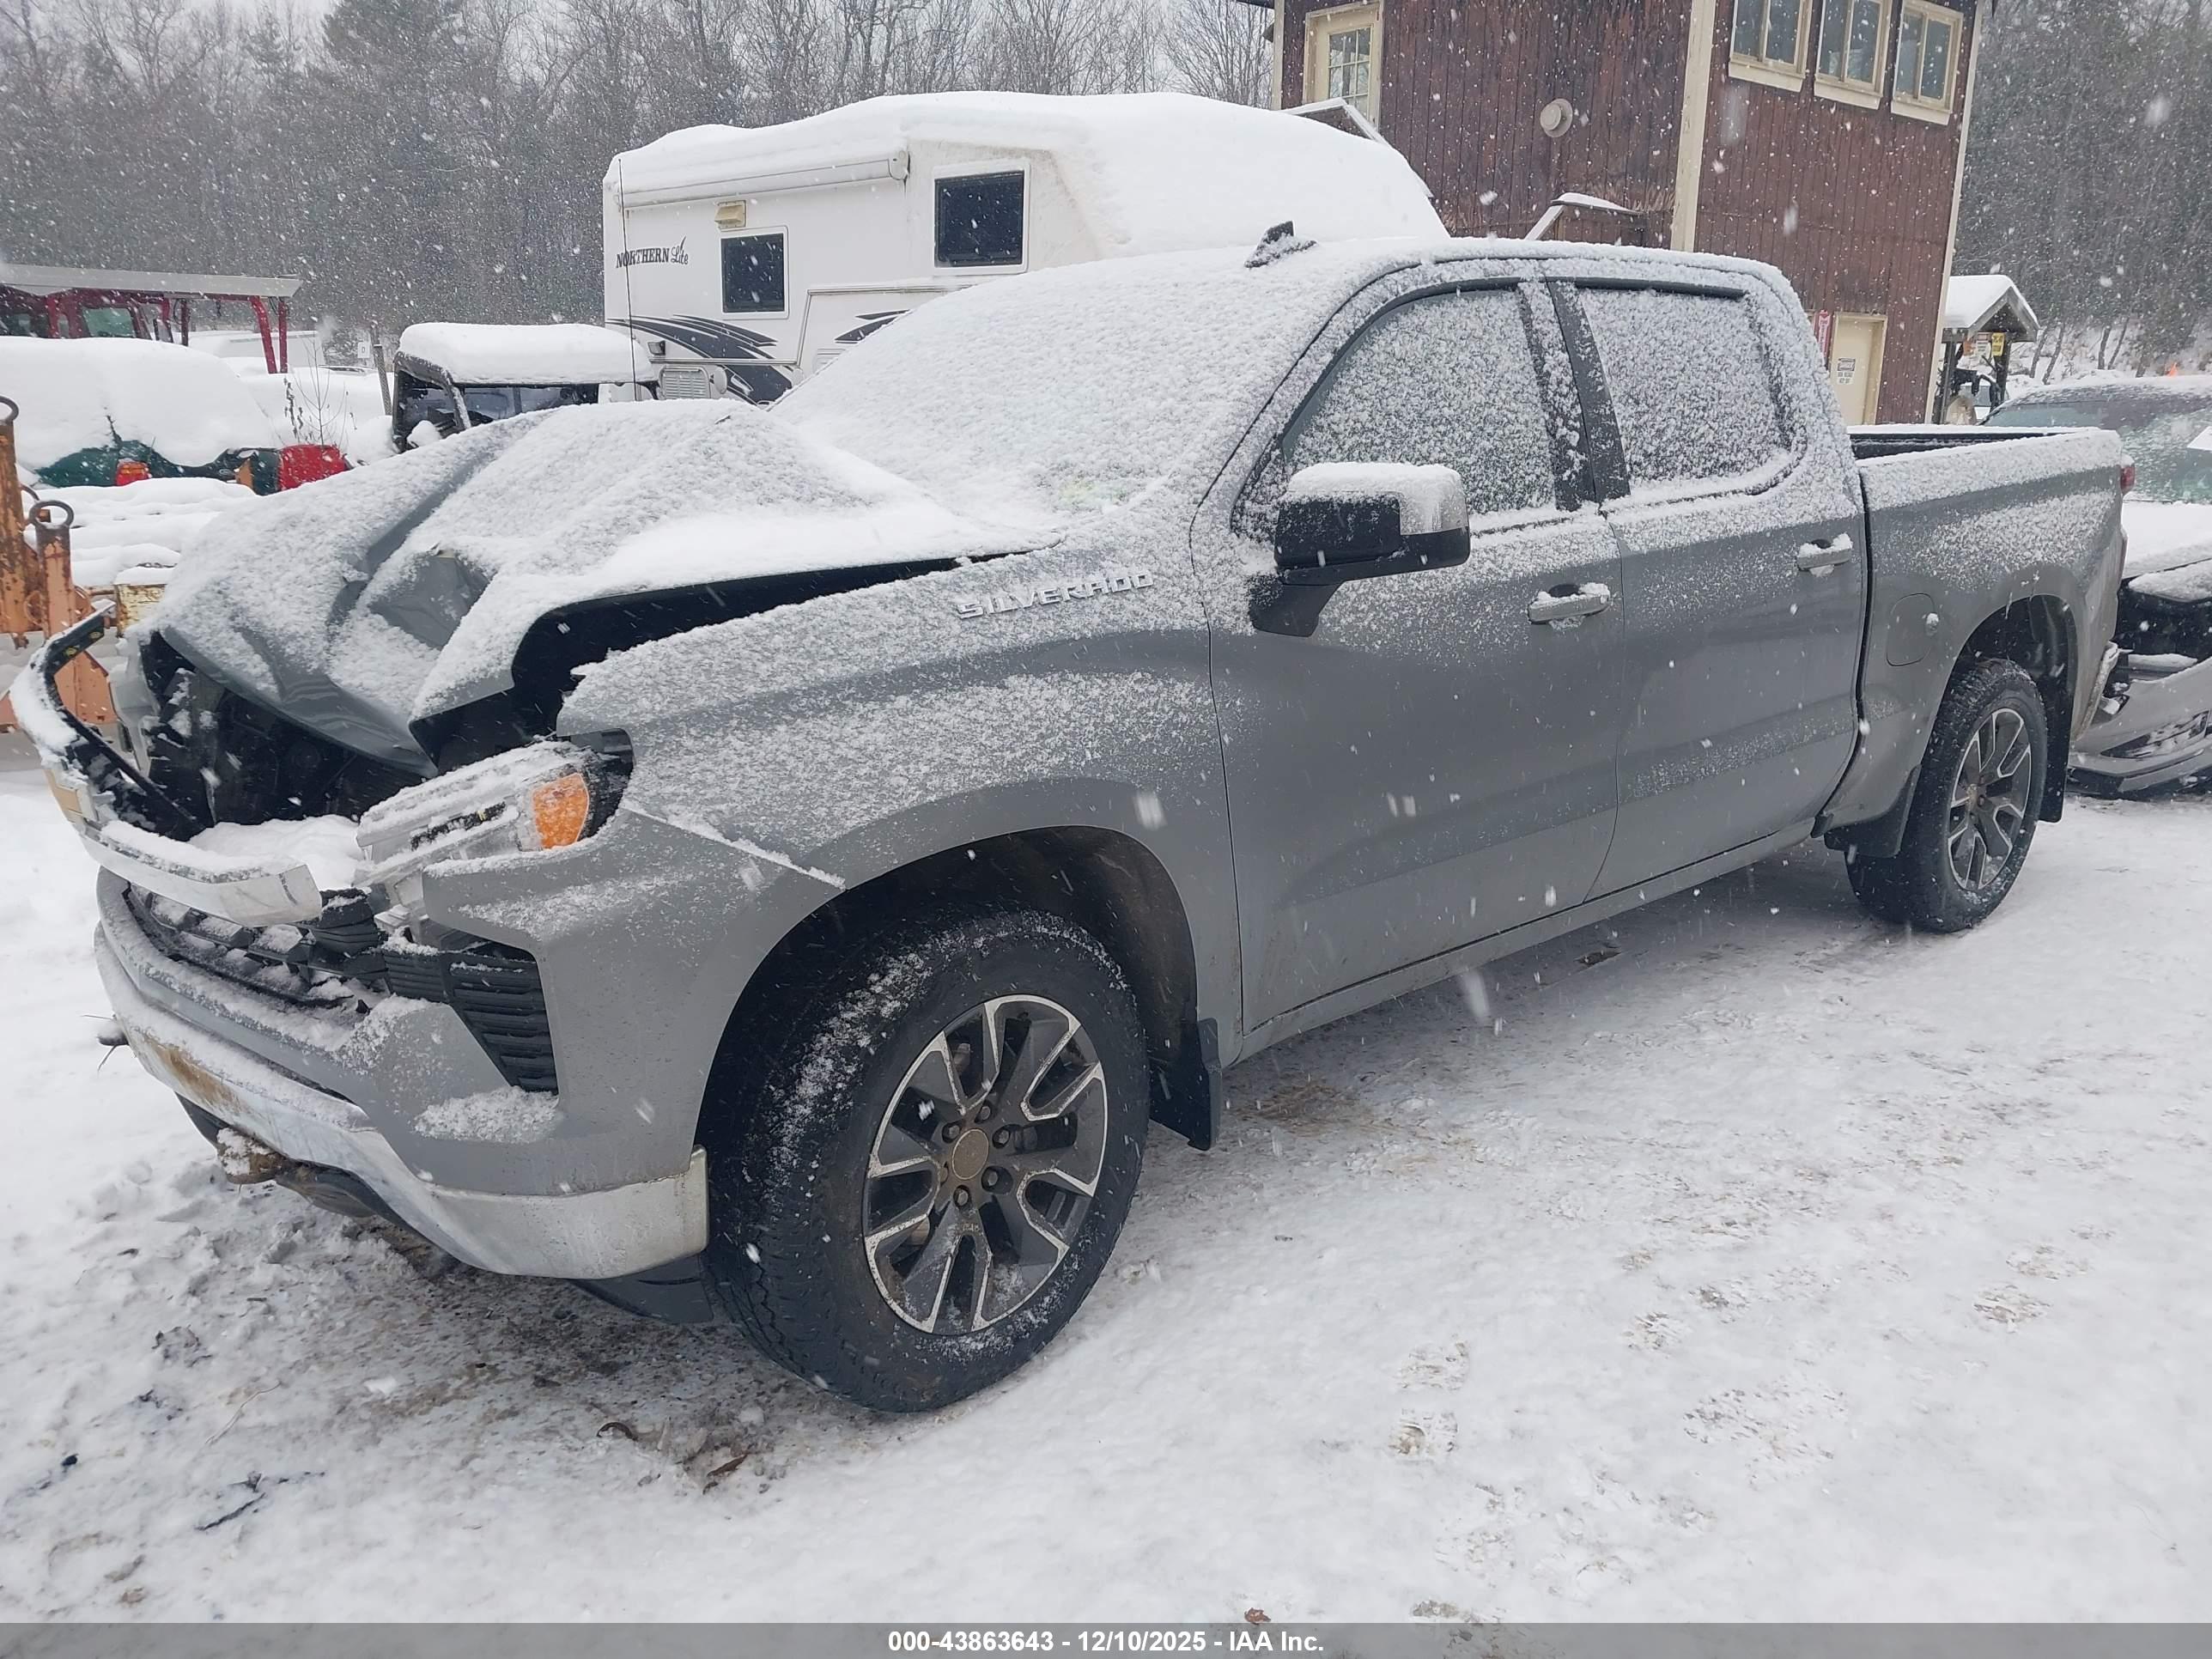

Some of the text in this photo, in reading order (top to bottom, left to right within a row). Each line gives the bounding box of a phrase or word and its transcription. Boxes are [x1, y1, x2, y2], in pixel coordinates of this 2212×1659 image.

[616, 235, 689, 268] NORTHERN Lite
[957, 572, 1154, 619] SILVERADO
